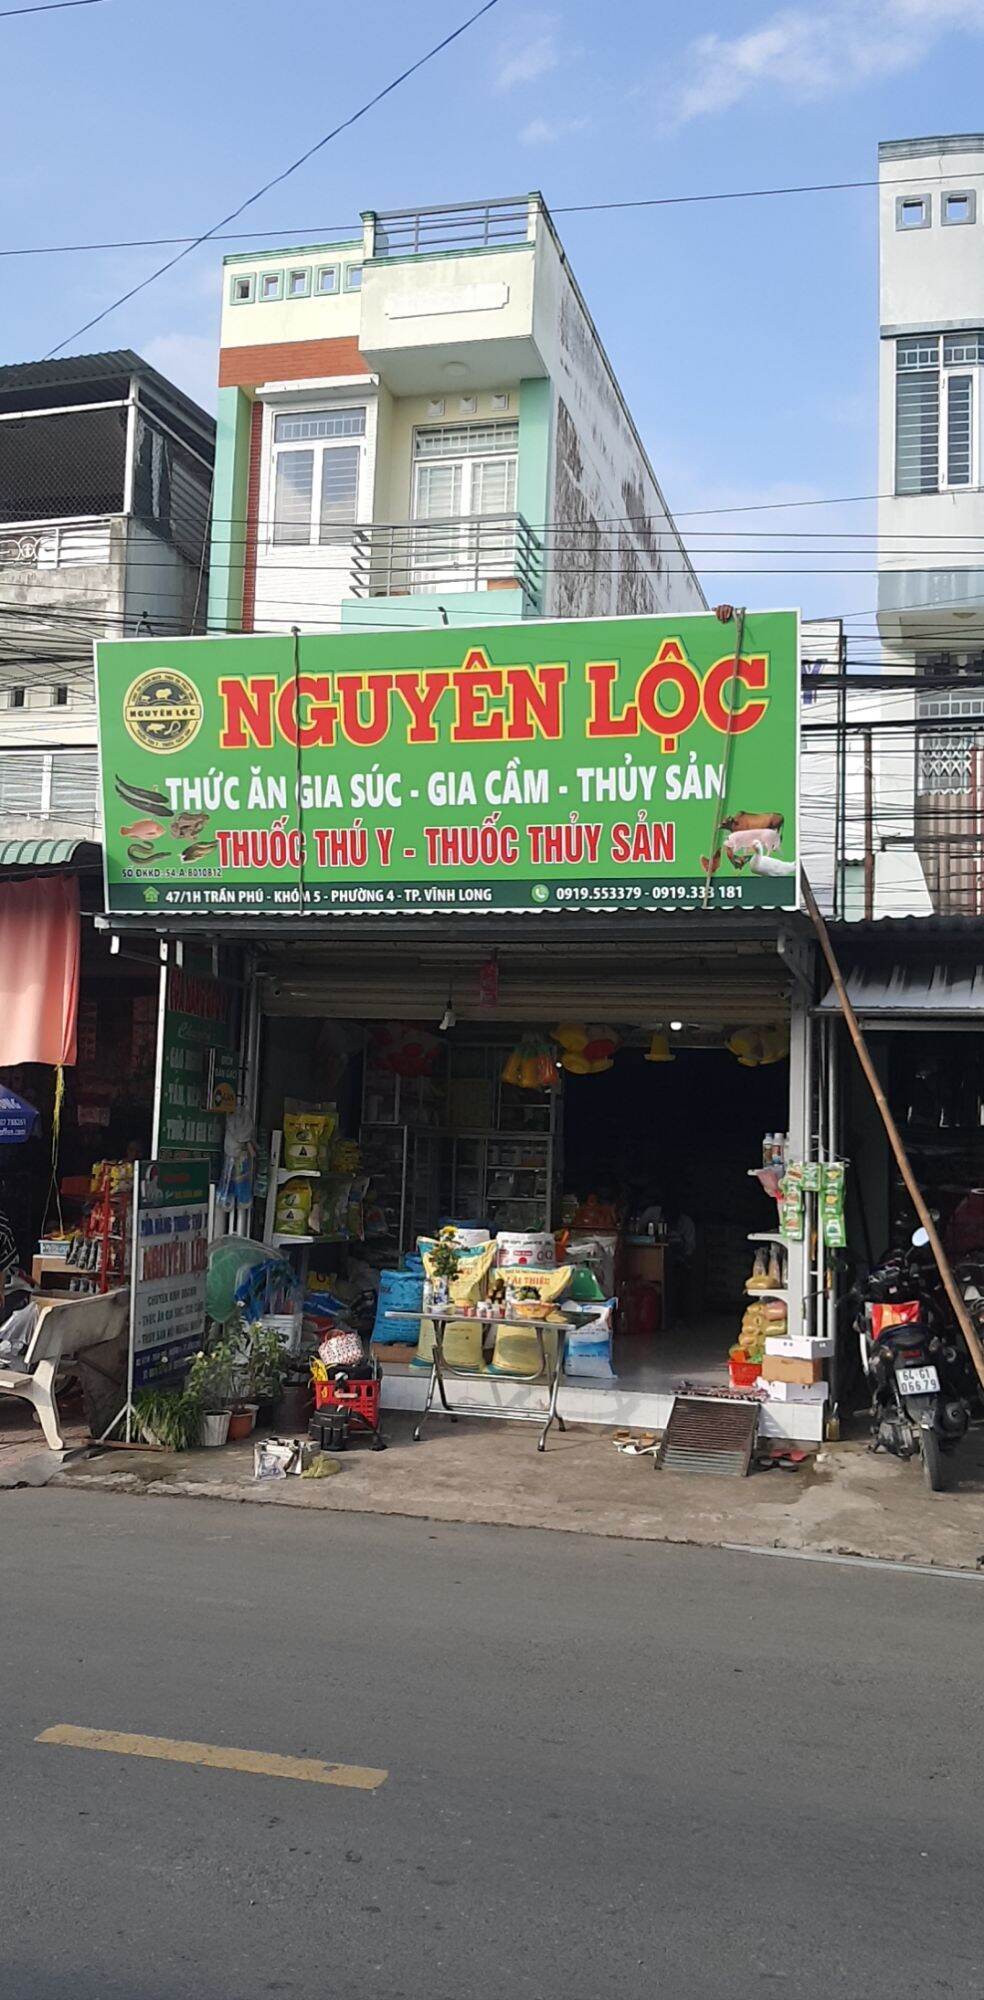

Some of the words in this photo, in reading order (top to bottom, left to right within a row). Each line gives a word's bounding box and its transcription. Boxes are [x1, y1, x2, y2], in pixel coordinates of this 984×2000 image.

[130, 709, 172, 718] NGUYÊN
[218, 646, 568, 749] NGUYÊN
[585, 636, 769, 753] LỘC
[165, 767, 240, 811] THỨC
[247, 765, 287, 809] ĂN
[294, 774, 343, 809] GIA
[350, 763, 402, 808] SÚC
[427, 771, 478, 807] GIA
[484, 756, 549, 805] CẦM
[576, 753, 657, 802] THỦY
[665, 750, 727, 800] SẢN
[216, 815, 306, 868] THUỐC
[314, 818, 369, 867] THÚ
[375, 827, 394, 866] Y
[424, 811, 519, 866] THUỐC
[527, 810, 603, 863] THỦY
[611, 809, 675, 863] SẢN
[165, 889, 201, 904] 47/1H
[238, 887, 265, 904] PHÚ
[274, 887, 311, 904] KHÓM
[313, 890, 321, 903] 5
[331, 887, 384, 903] PHƯỜNG
[386, 889, 395, 902] 4
[404, 889, 422, 902] TP.
[425, 886, 456, 902] VĨNH
[459, 888, 492, 901] LONG
[556, 886, 642, 900] 0919.553379
[719, 885, 743, 899] 181
